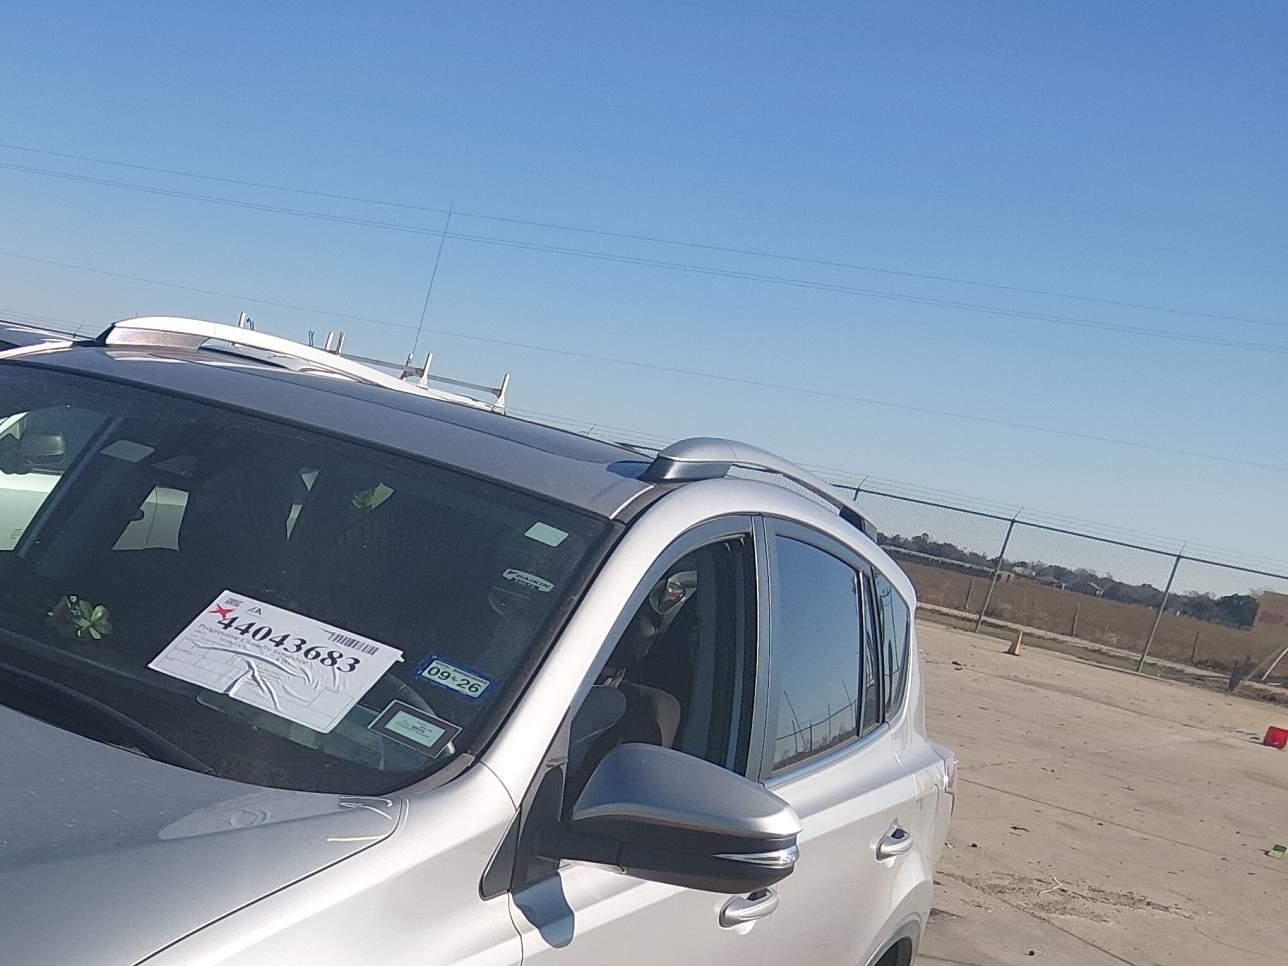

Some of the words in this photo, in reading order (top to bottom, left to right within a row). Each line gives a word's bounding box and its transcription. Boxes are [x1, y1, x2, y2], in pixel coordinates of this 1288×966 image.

[216, 616, 361, 673] 44043683
[427, 667, 451, 680] 09
[456, 679, 481, 693] 26
